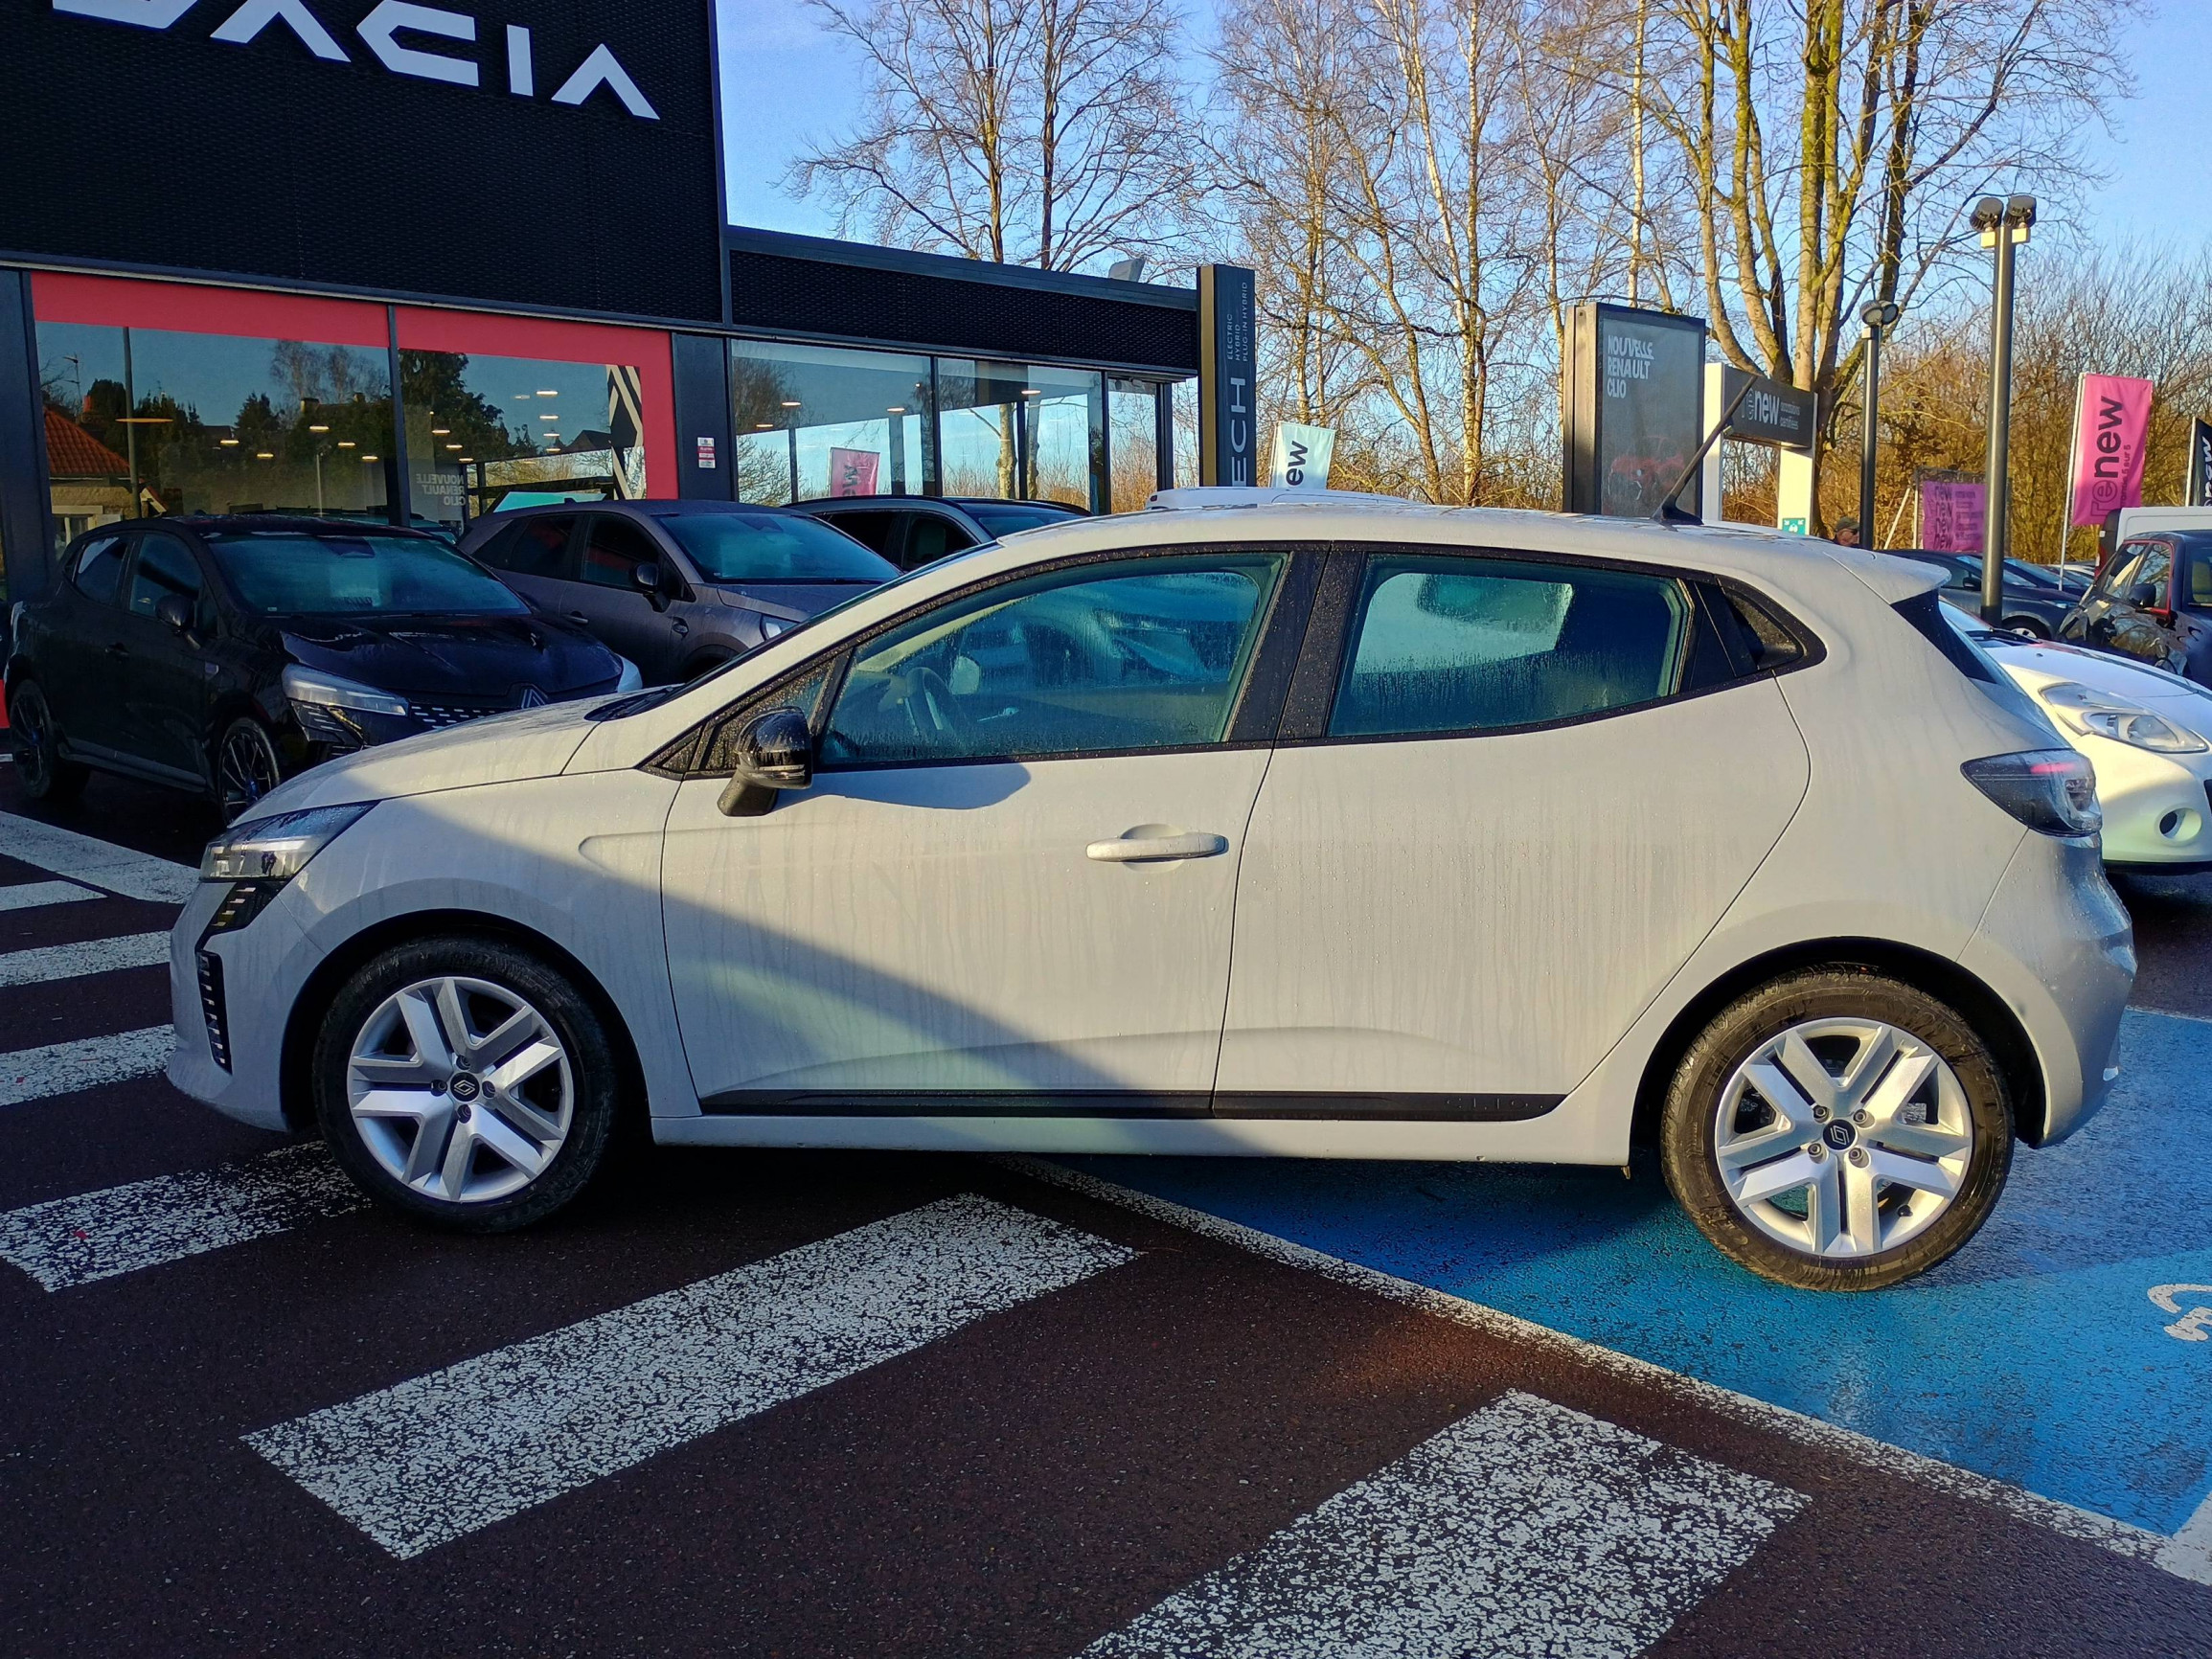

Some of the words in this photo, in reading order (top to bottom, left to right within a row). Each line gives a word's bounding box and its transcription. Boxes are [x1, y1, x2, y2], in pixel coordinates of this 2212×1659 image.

[1608, 334, 1654, 360] NOUVELLE
[1607, 356, 1651, 379] RENAULT
[1607, 377, 1627, 398] CLIO
[1286, 441, 1308, 486] ew
[2090, 396, 2124, 517] renew
